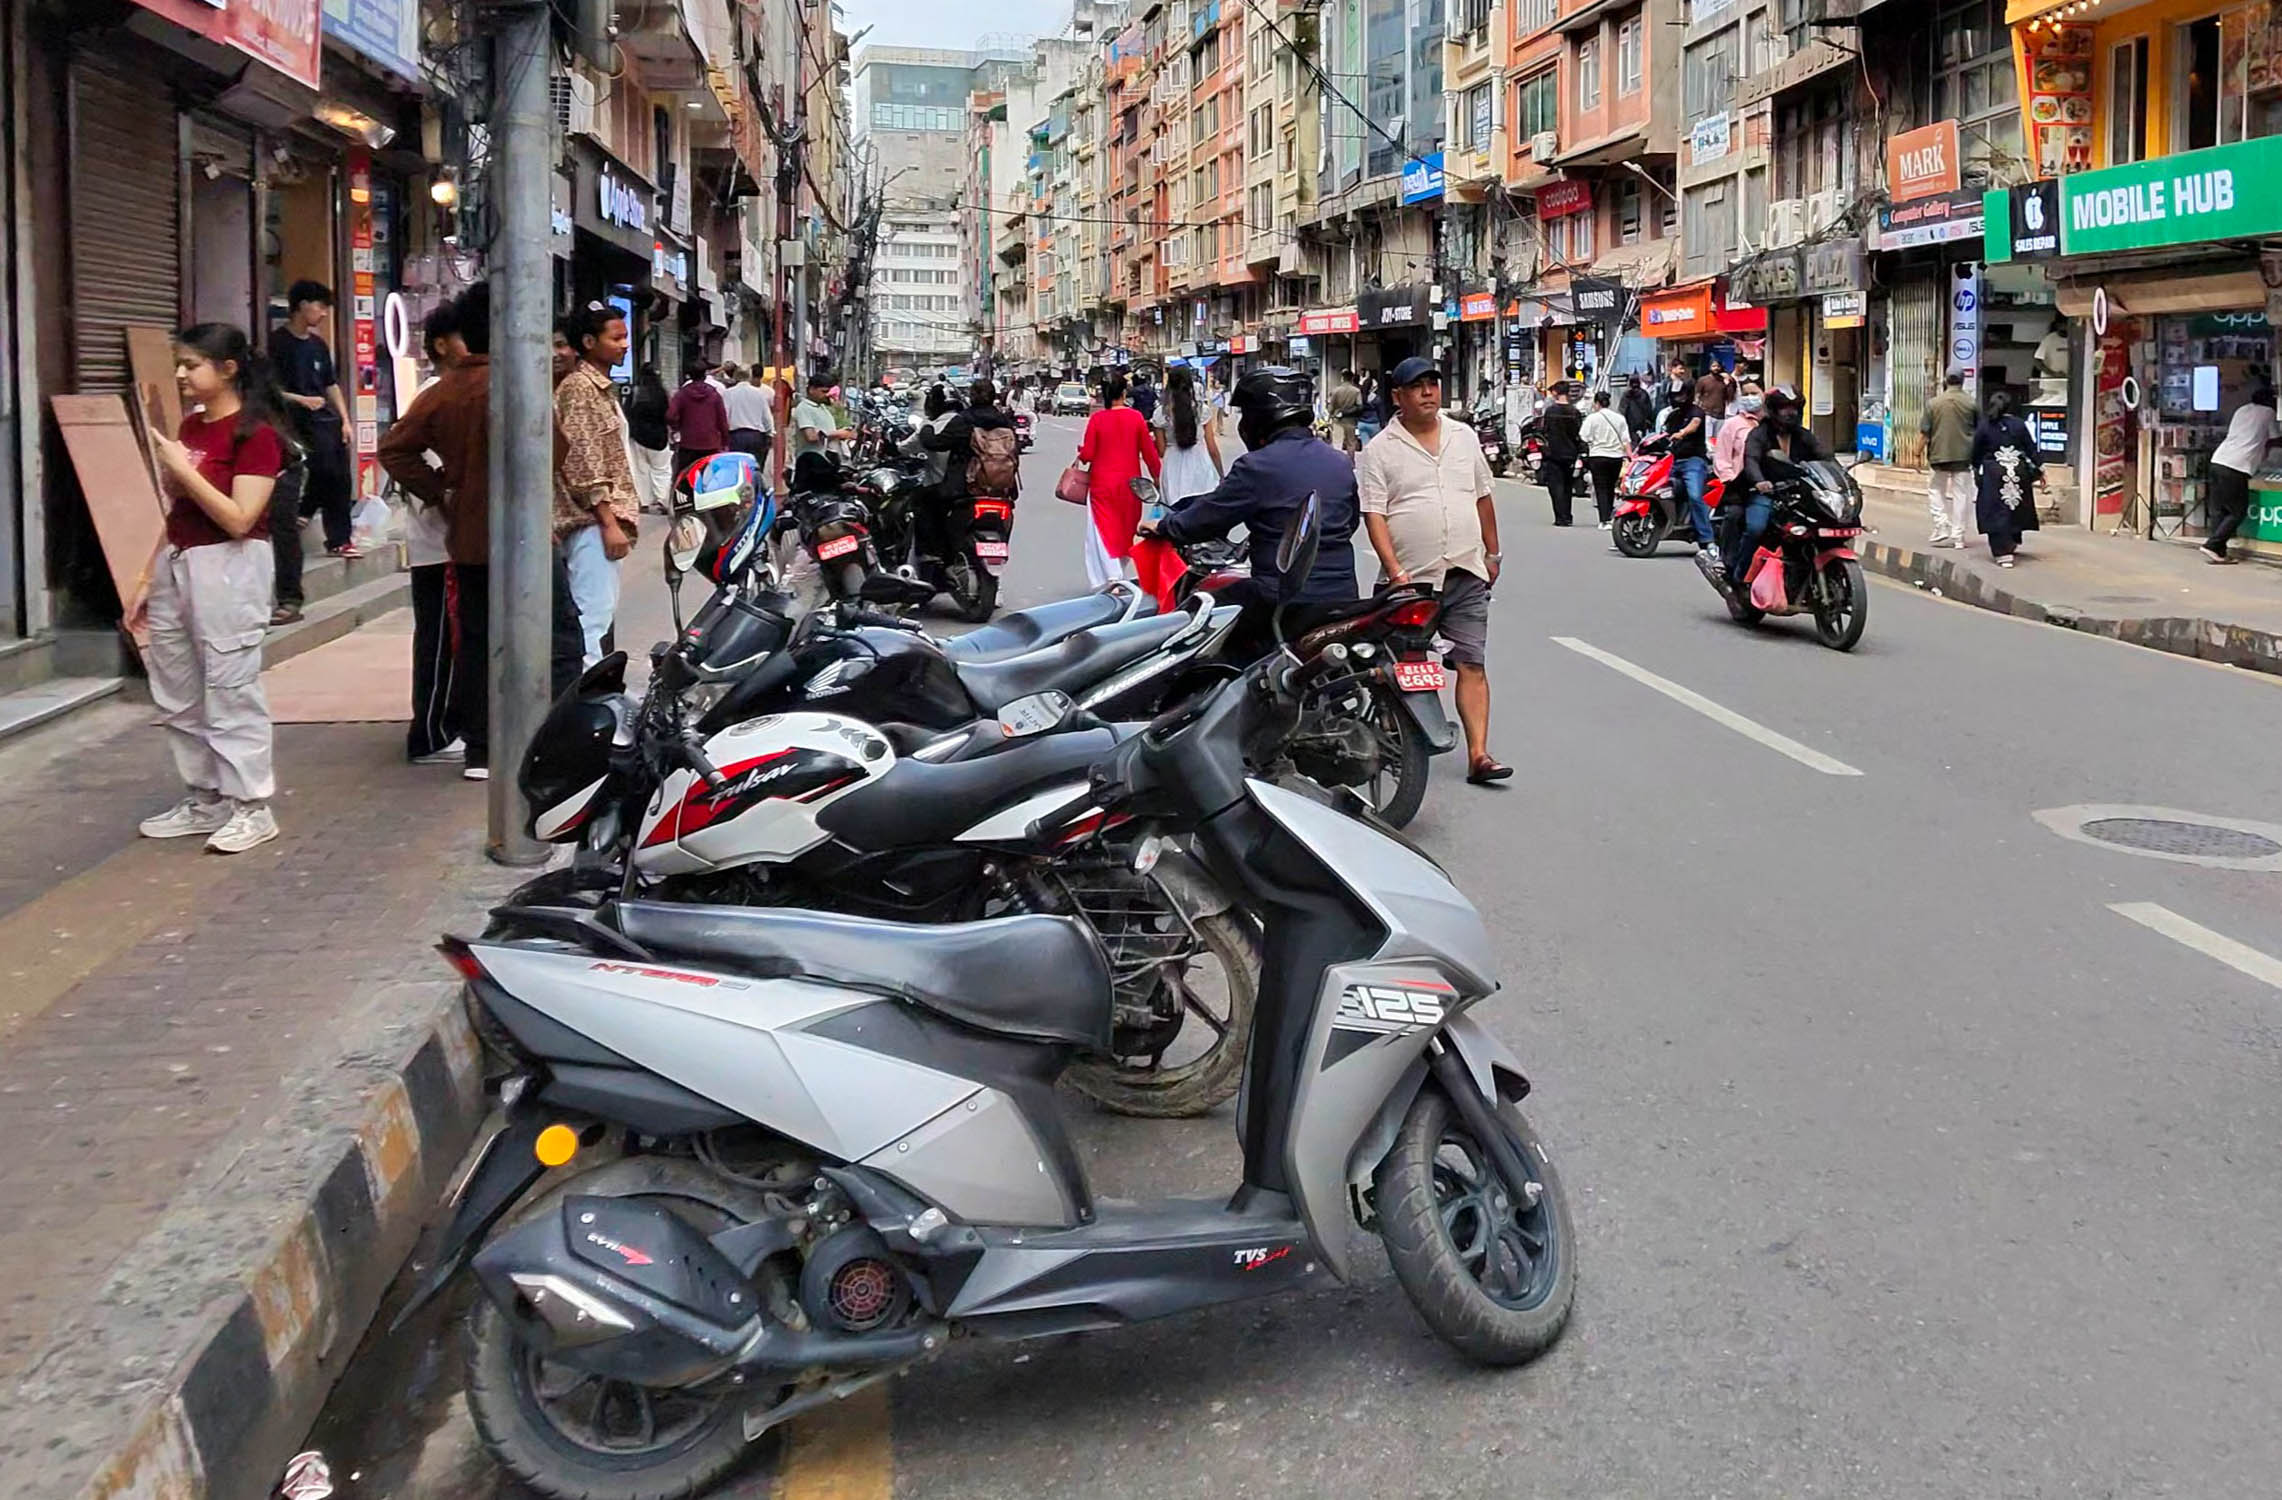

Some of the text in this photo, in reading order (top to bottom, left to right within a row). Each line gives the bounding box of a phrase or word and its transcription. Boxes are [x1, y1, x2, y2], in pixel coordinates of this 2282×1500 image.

[1899, 144, 1945, 181] MARK
[2073, 169, 2234, 231] MOBILE HUB
[2015, 235, 2056, 253] SALES REPAIR
[1578, 289, 1615, 311] SAMSUNG
[805, 685, 851, 700] HONDA
[1234, 1248, 1267, 1264] TVS
